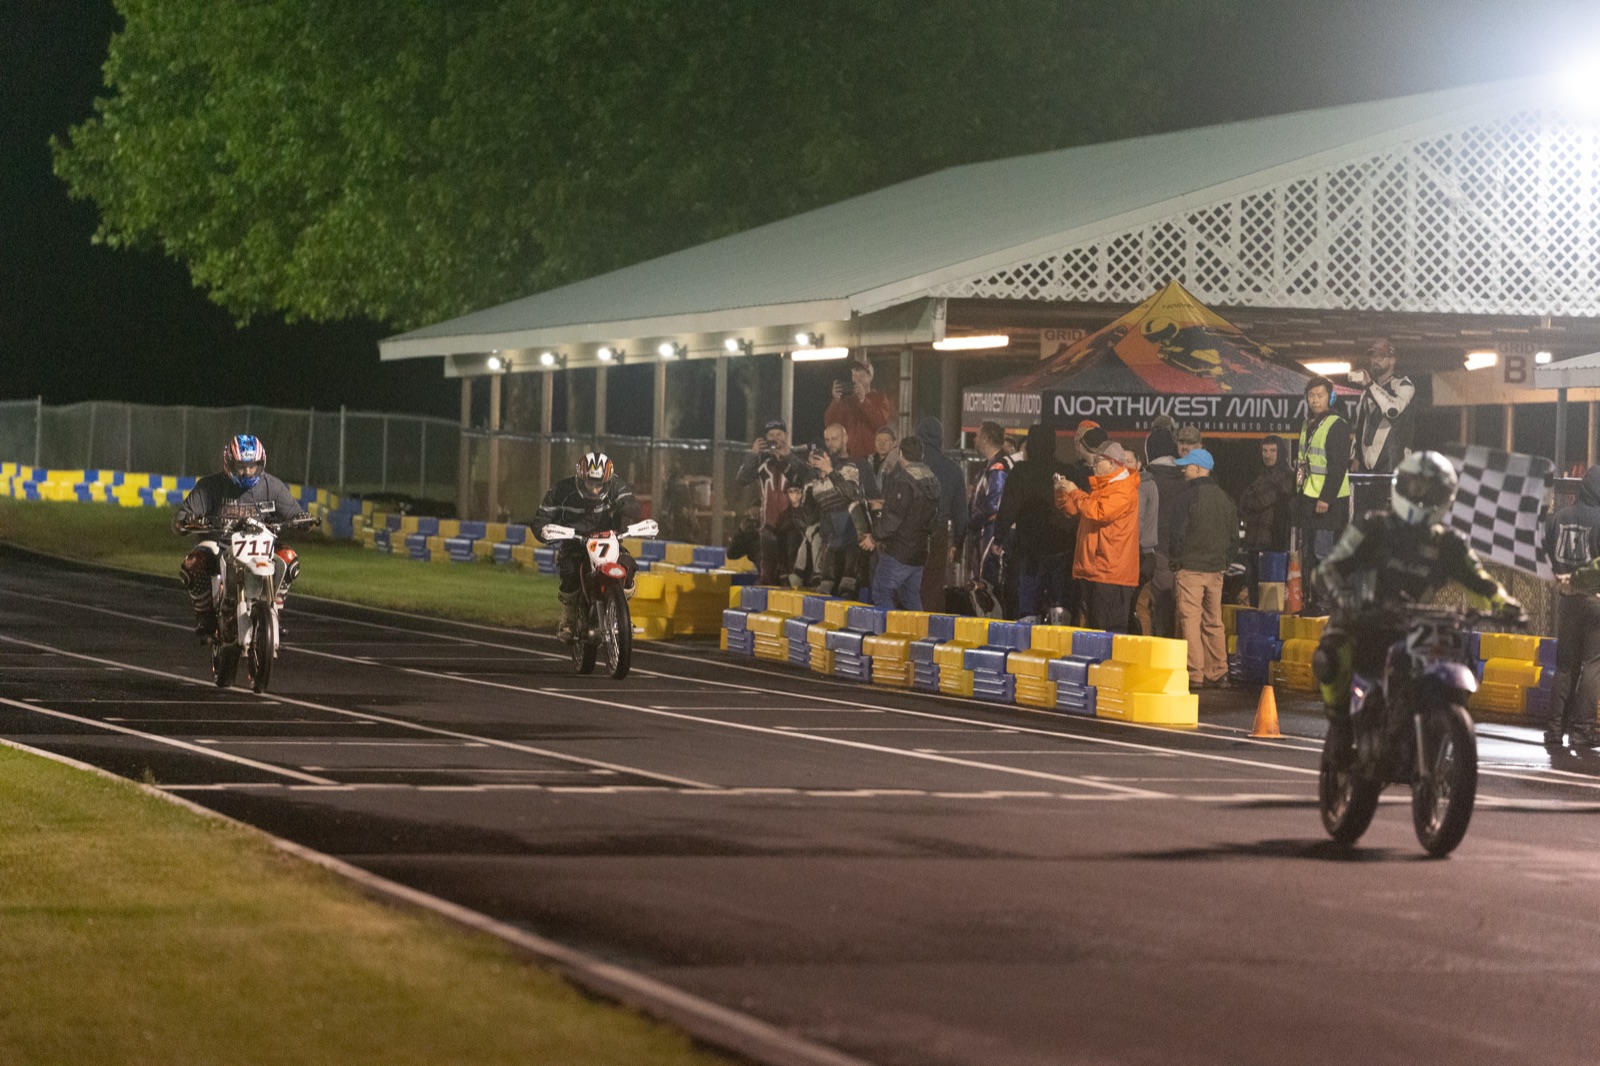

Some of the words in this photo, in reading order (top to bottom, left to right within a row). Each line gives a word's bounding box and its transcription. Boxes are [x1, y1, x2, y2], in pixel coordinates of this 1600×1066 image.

[1044, 330, 1082, 341] GRID
[1504, 355, 1526, 384] B
[963, 392, 1005, 413] NORTHWEST
[1053, 395, 1222, 417] NORTHWEST
[1225, 397, 1289, 418] MINI
[234, 540, 271, 557] 711
[598, 543, 610, 558] 7
